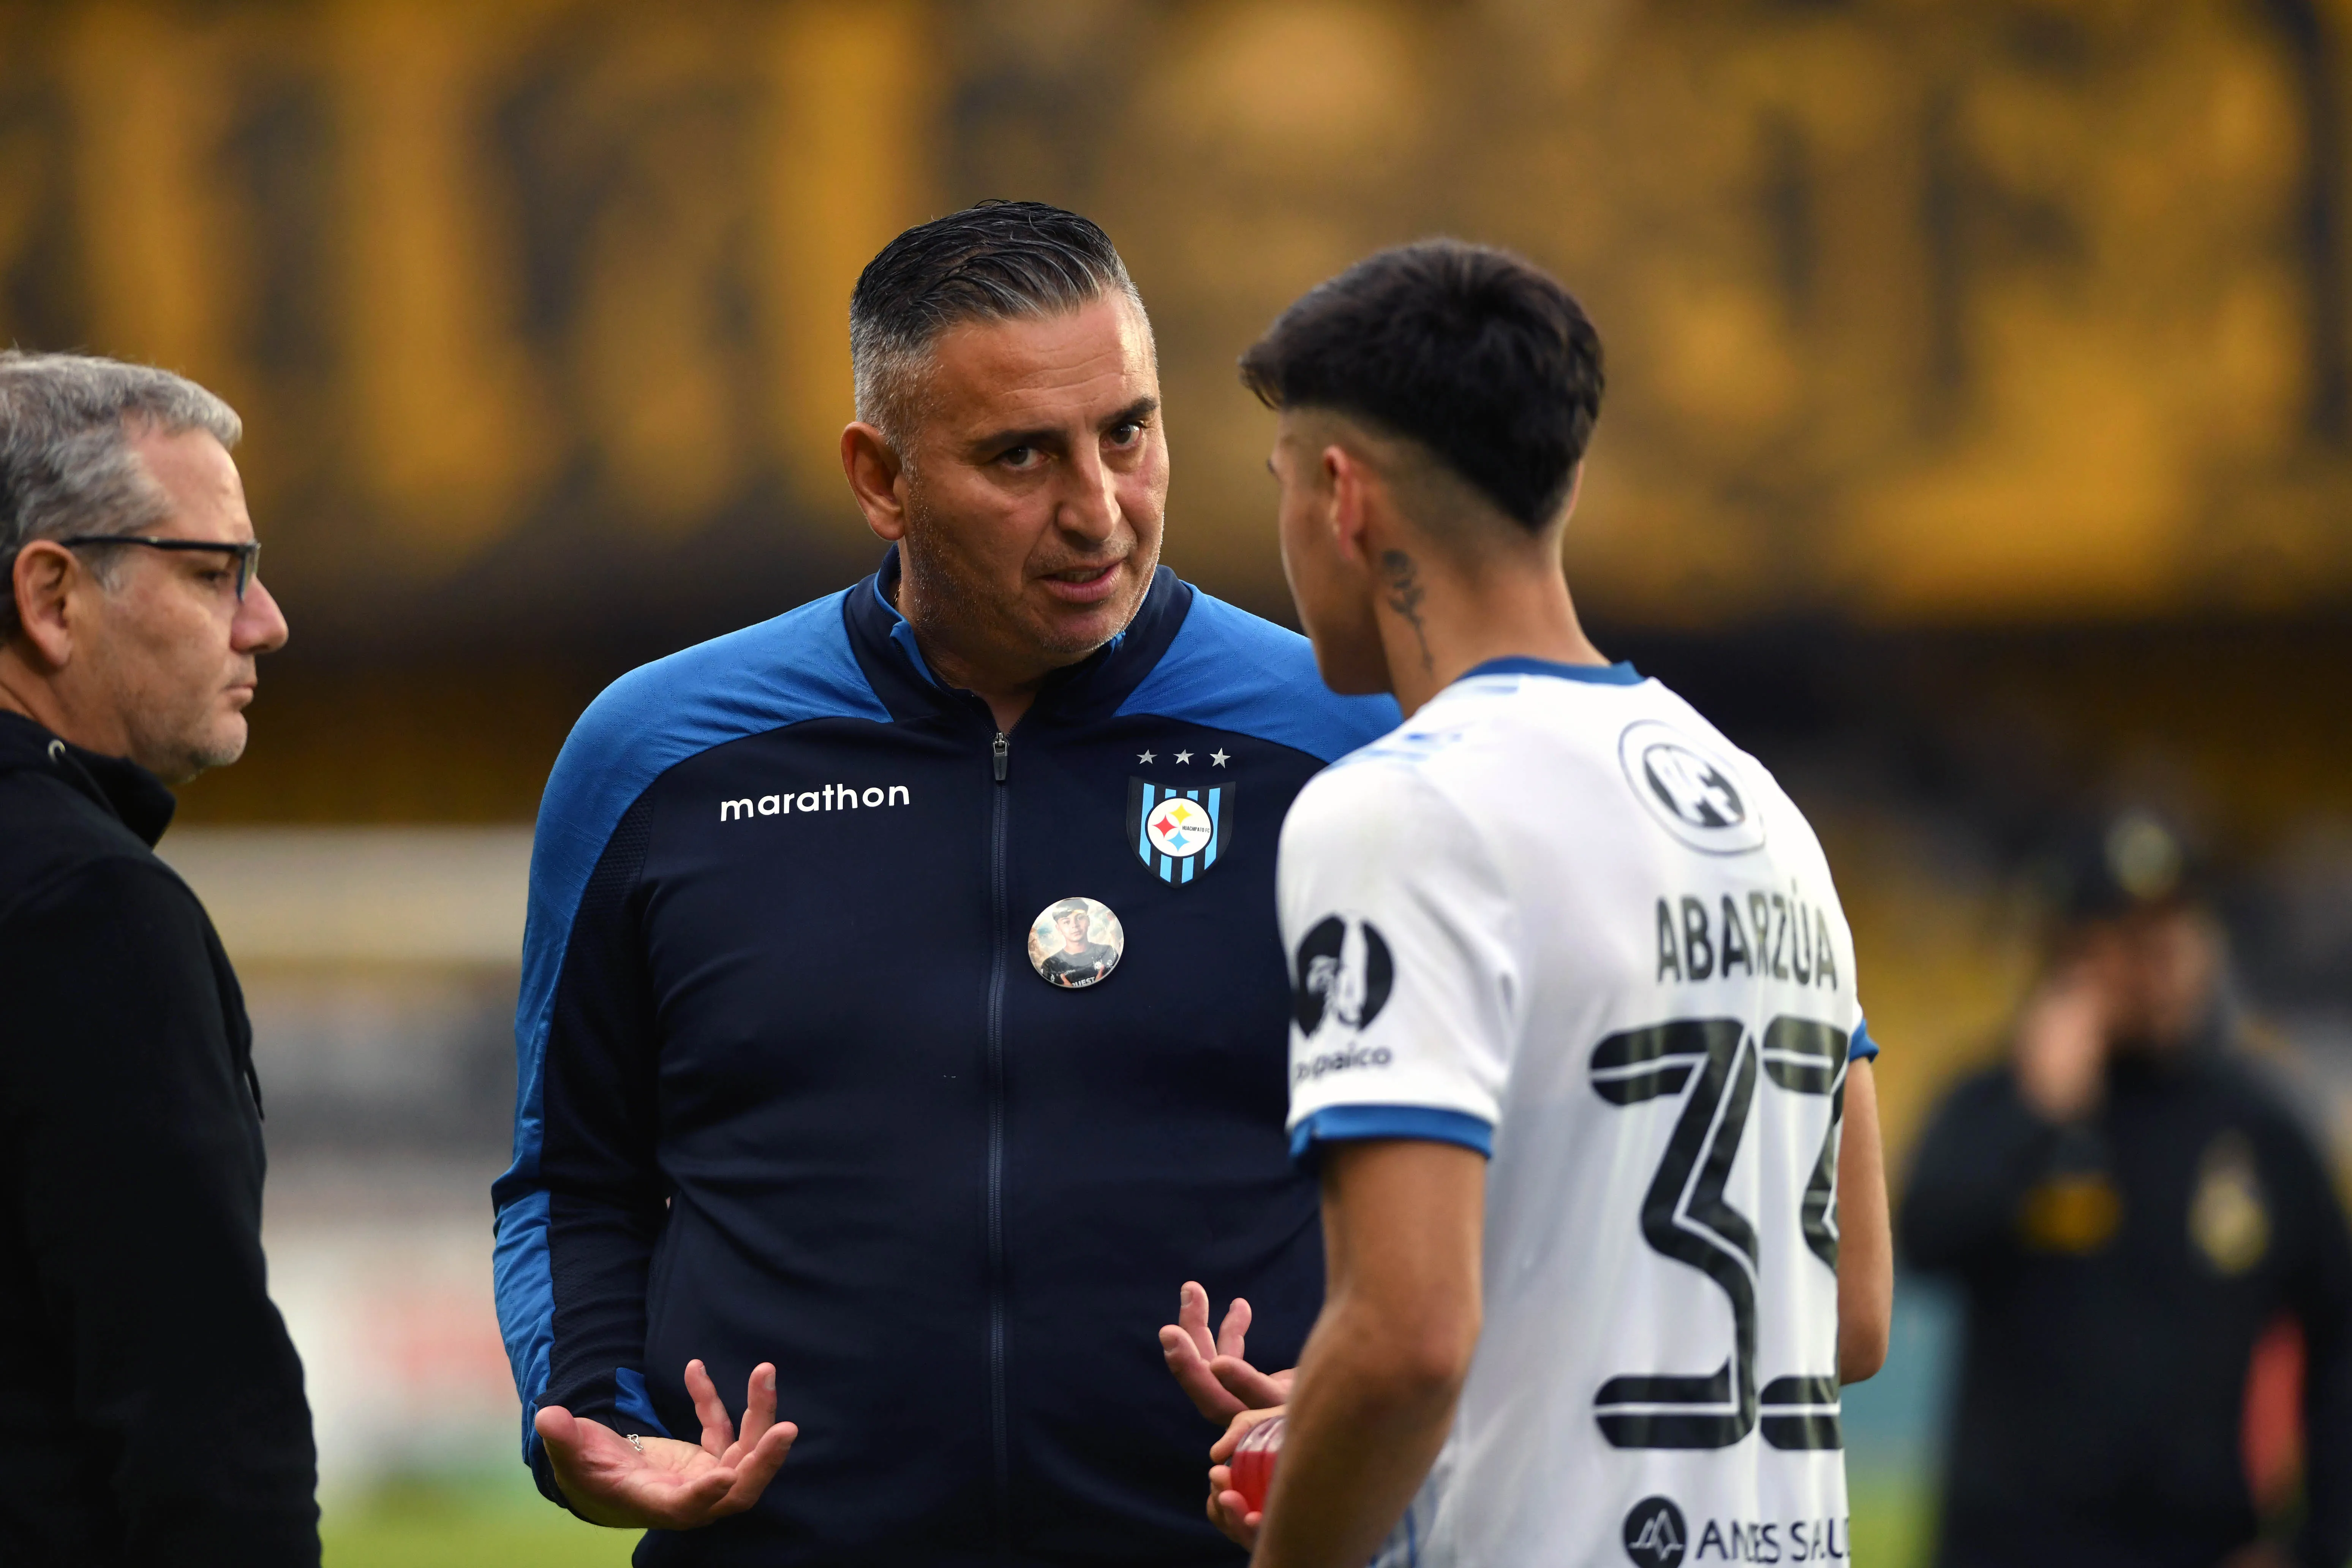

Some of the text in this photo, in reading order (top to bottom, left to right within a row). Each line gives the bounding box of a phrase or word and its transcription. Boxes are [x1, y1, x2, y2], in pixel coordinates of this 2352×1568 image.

[721, 783, 910, 822] marathon
[1657, 877, 1837, 991] ABARZÚA
[1589, 1015, 1848, 1449] 33
